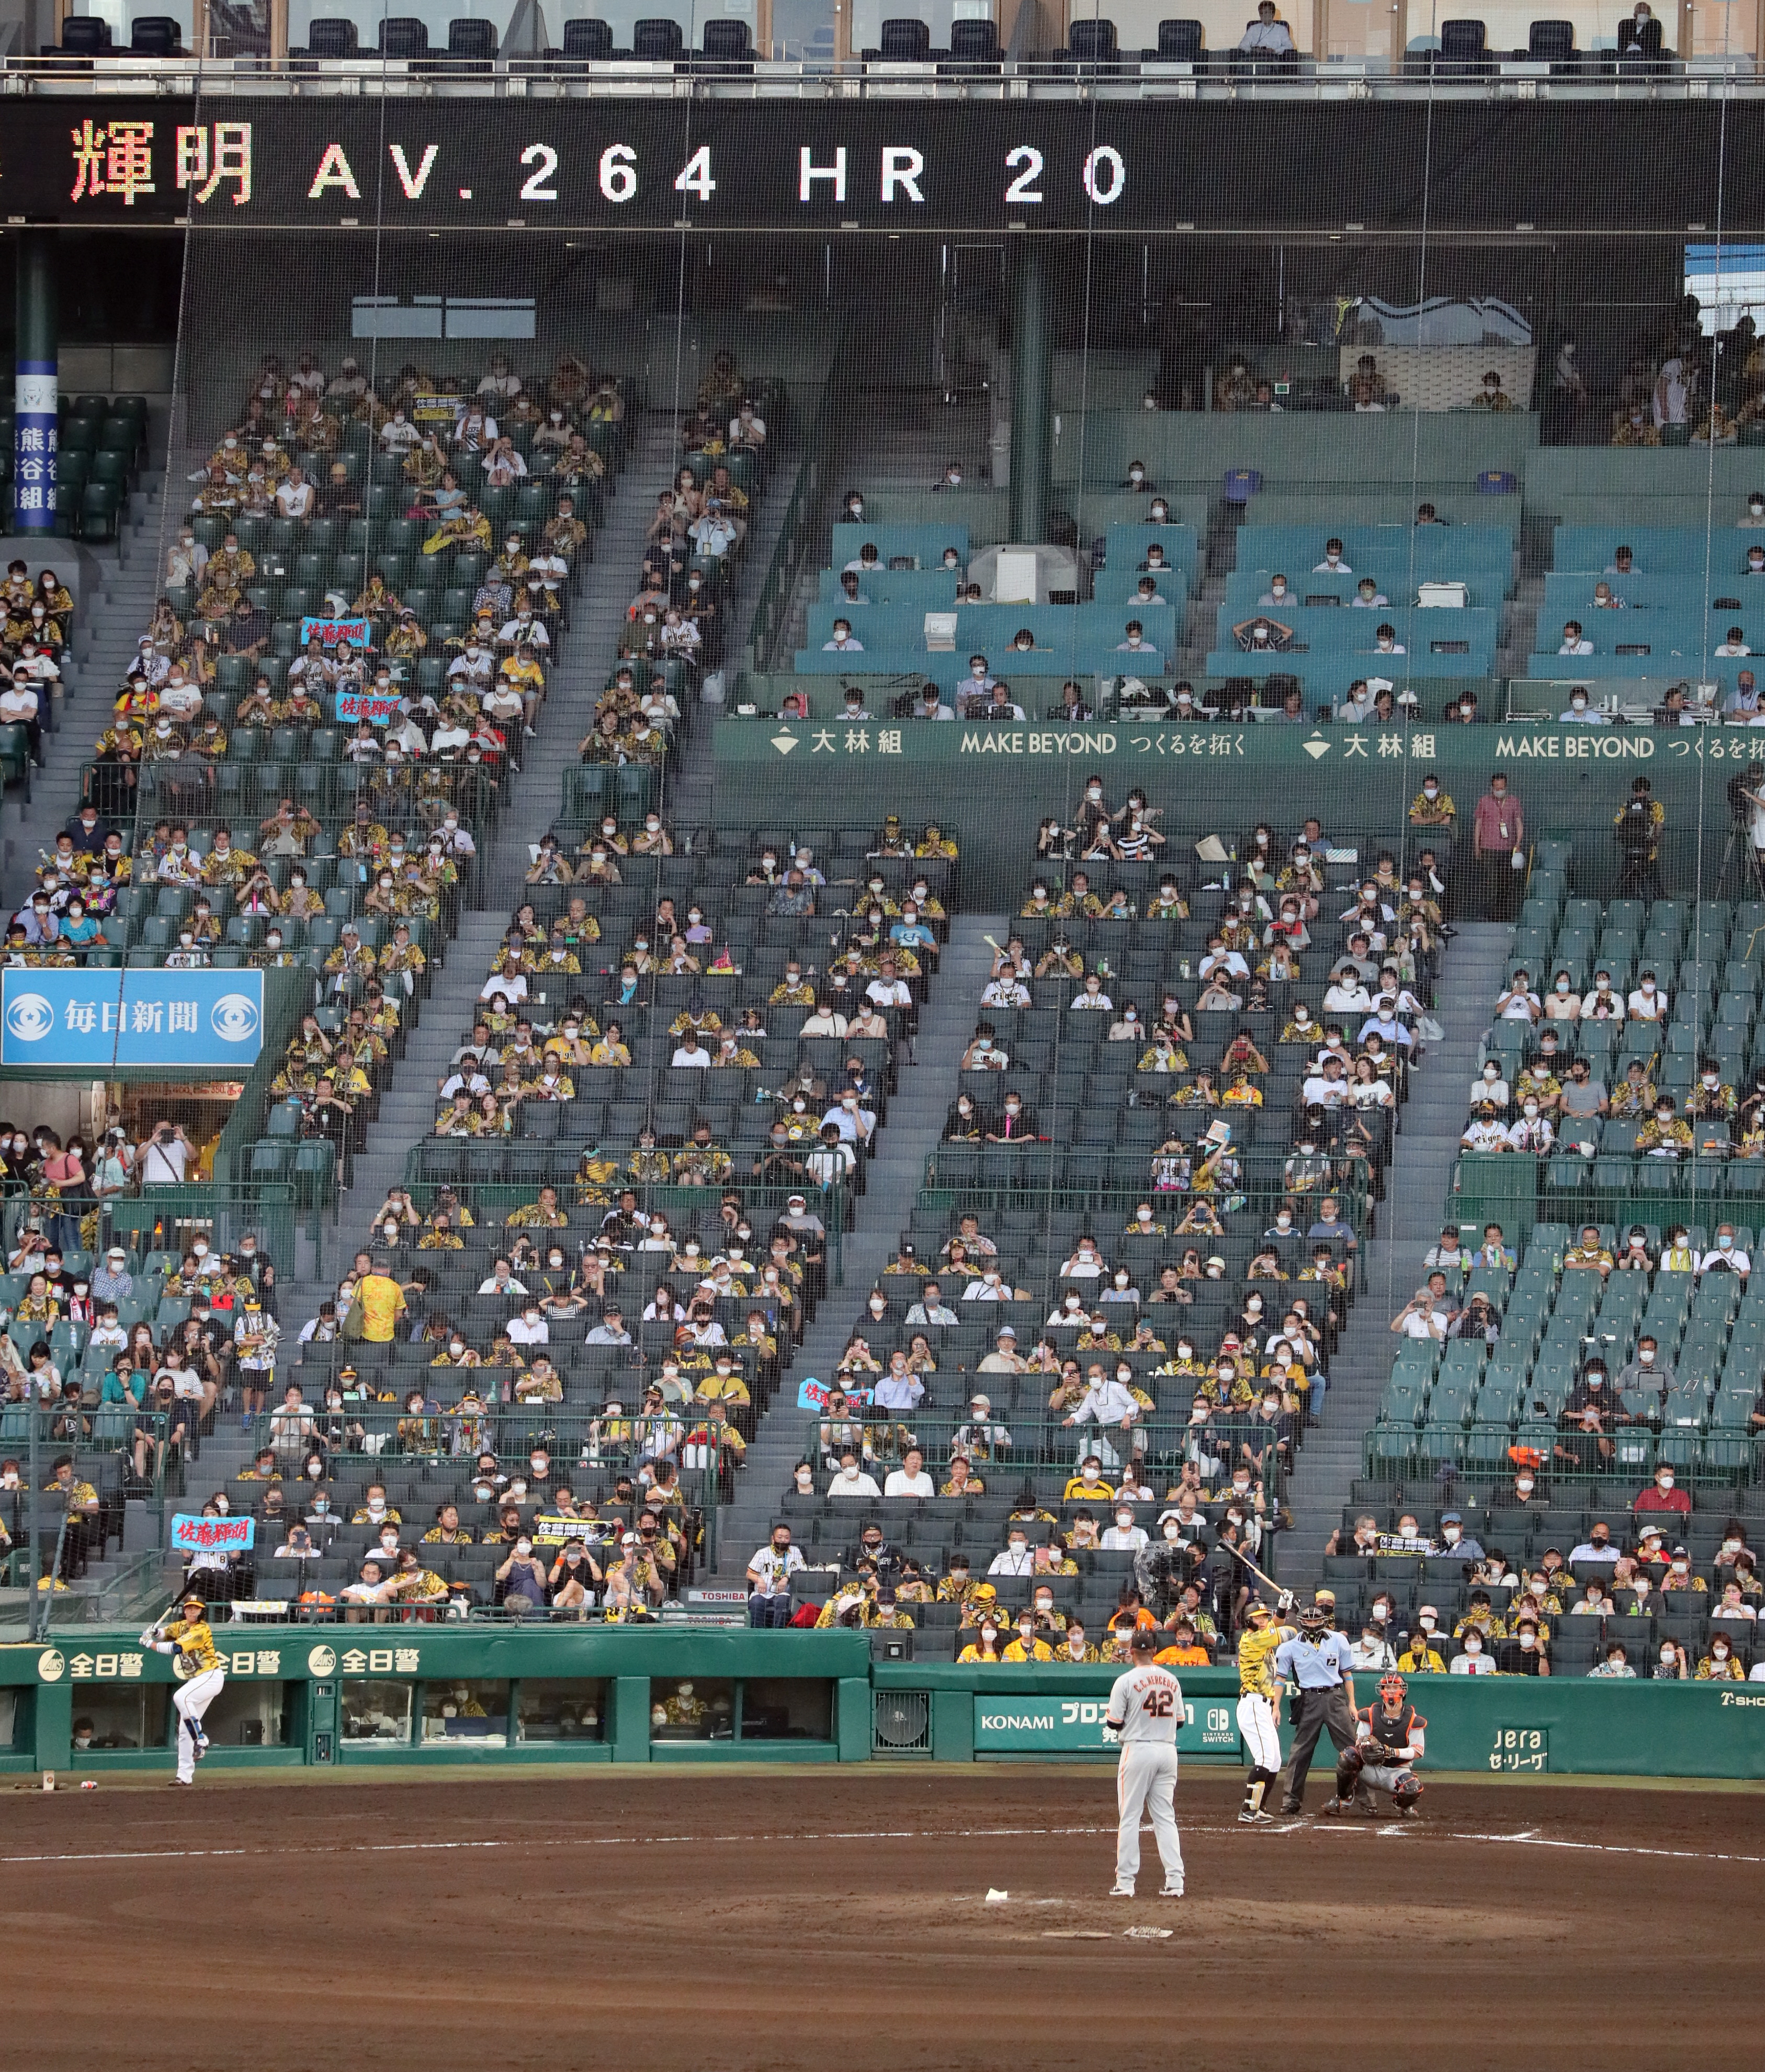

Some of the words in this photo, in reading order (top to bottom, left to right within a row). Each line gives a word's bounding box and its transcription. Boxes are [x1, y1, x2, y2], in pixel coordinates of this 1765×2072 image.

[71, 120, 252, 205] 輝明
[799, 146, 925, 202] HR
[1005, 145, 1125, 204] 20
[20, 426, 45, 510] 熊谷組
[811, 729, 902, 753] 大林組
[960, 731, 1024, 754] MAKE
[1028, 732, 1117, 755] BEYOND
[1129, 733, 1244, 756] つくるを拓く
[1343, 733, 1436, 758] 大林組
[1495, 735, 1559, 758] MAKE
[1565, 735, 1655, 759] BEYOND
[64, 999, 199, 1033] 毎日新聞
[177, 1519, 250, 1547] 佐藤輝明
[220, 1555, 225, 1564] 8
[701, 1592, 745, 1601] TOSHIBA
[44, 1657, 63, 1671] ANS
[69, 1652, 144, 1678] 全日警
[315, 1654, 335, 1667] ANS
[341, 1648, 421, 1673] 全日警
[1142, 1690, 1174, 1718] 42
[981, 1715, 1054, 1730] KONAMI
